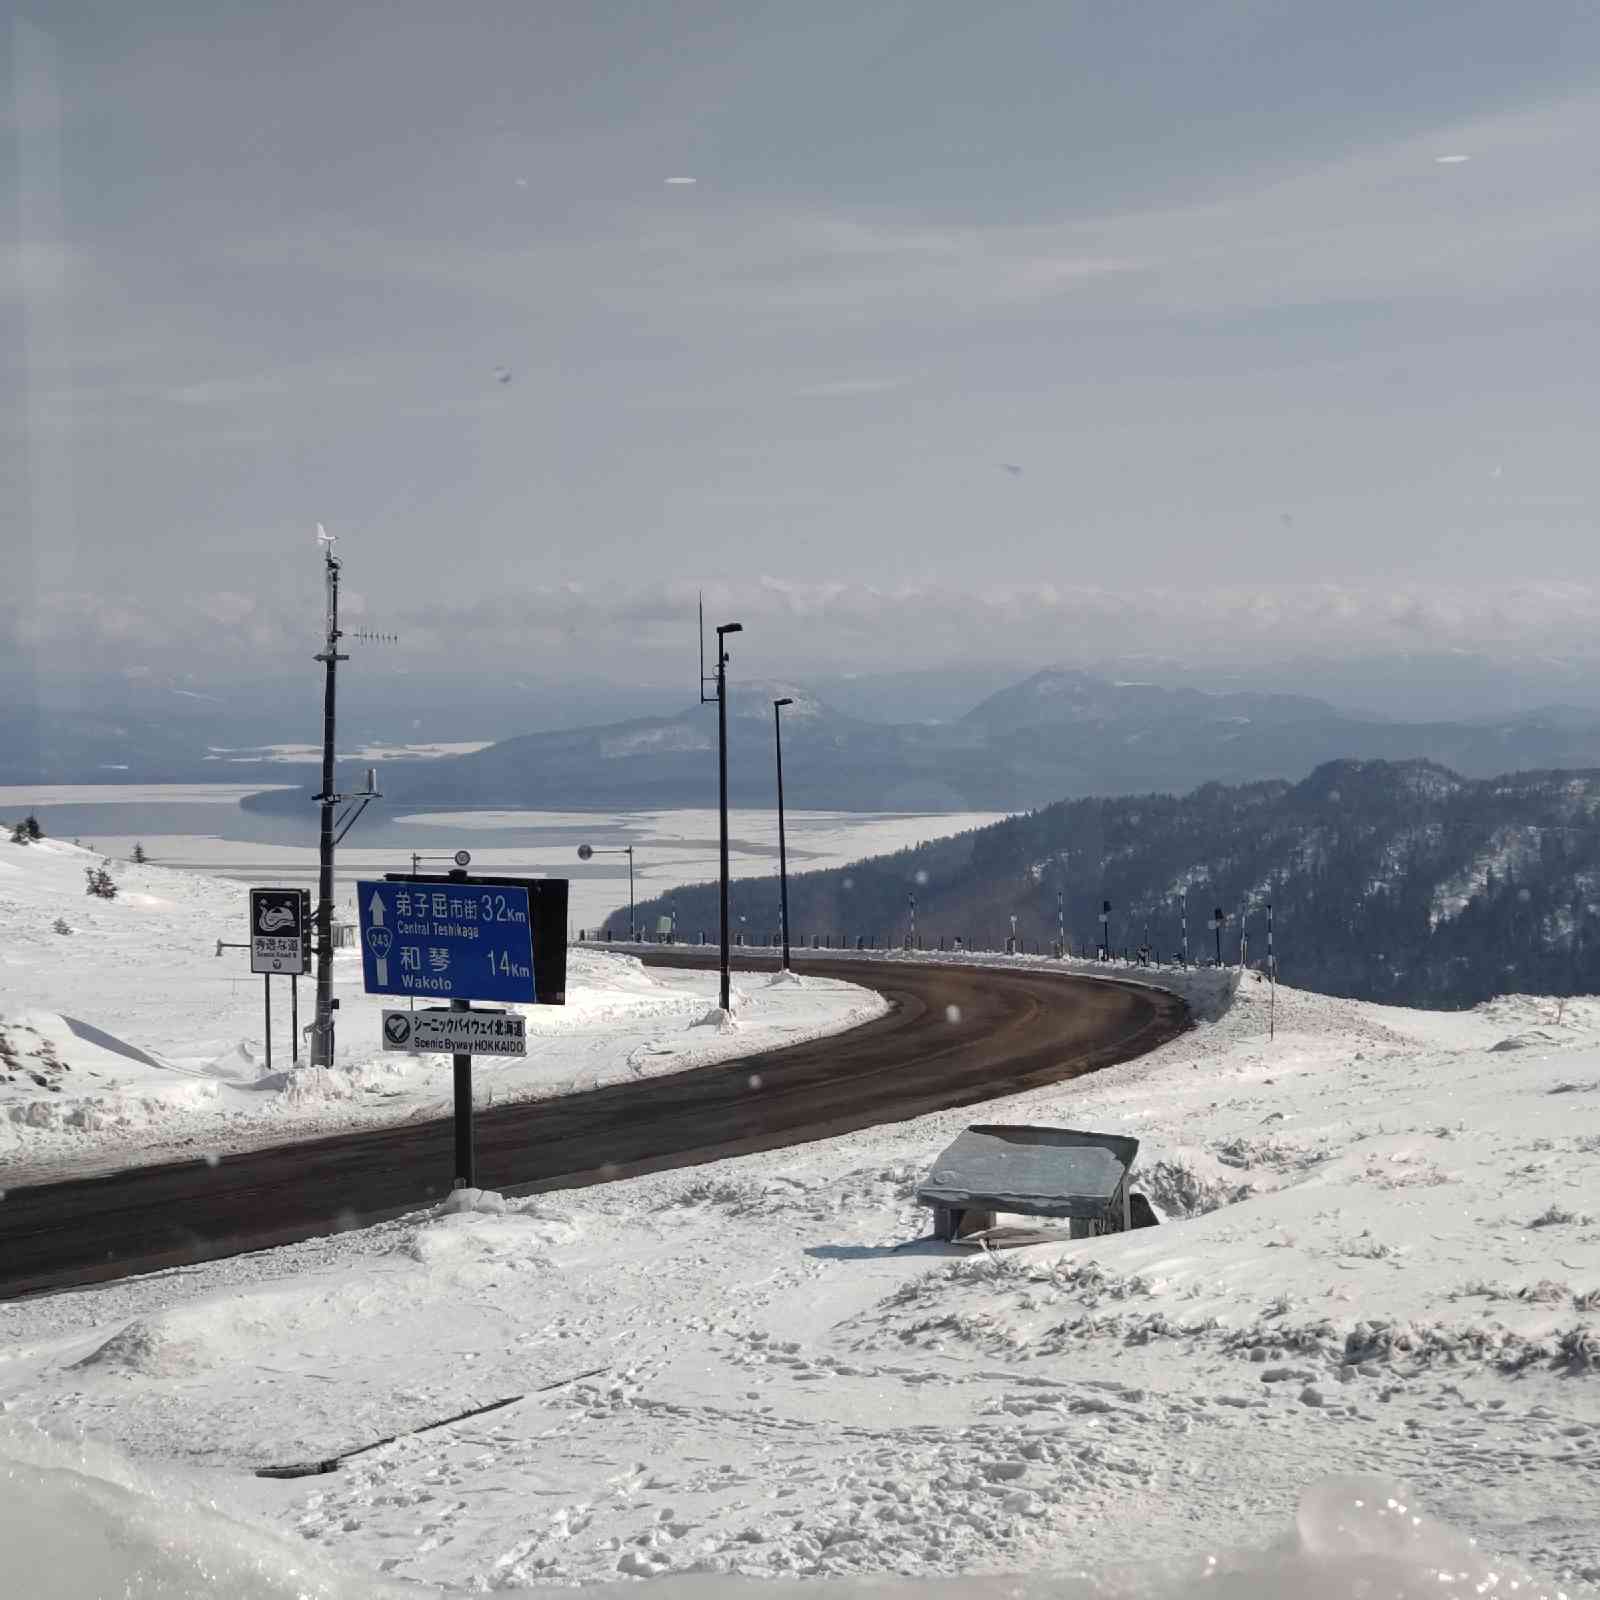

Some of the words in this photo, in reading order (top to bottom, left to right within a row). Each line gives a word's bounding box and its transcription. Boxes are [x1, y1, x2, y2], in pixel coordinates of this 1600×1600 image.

[397, 920, 430, 937] Central
[433, 922, 479, 939] Teshikaga
[401, 975, 452, 990] Wakoto
[414, 1016, 523, 1038] シーニックバイウェイ北海道
[414, 1037, 443, 1049] Scenic
[445, 1039, 473, 1053] Byway
[475, 1041, 524, 1053] HOKKAIDO
